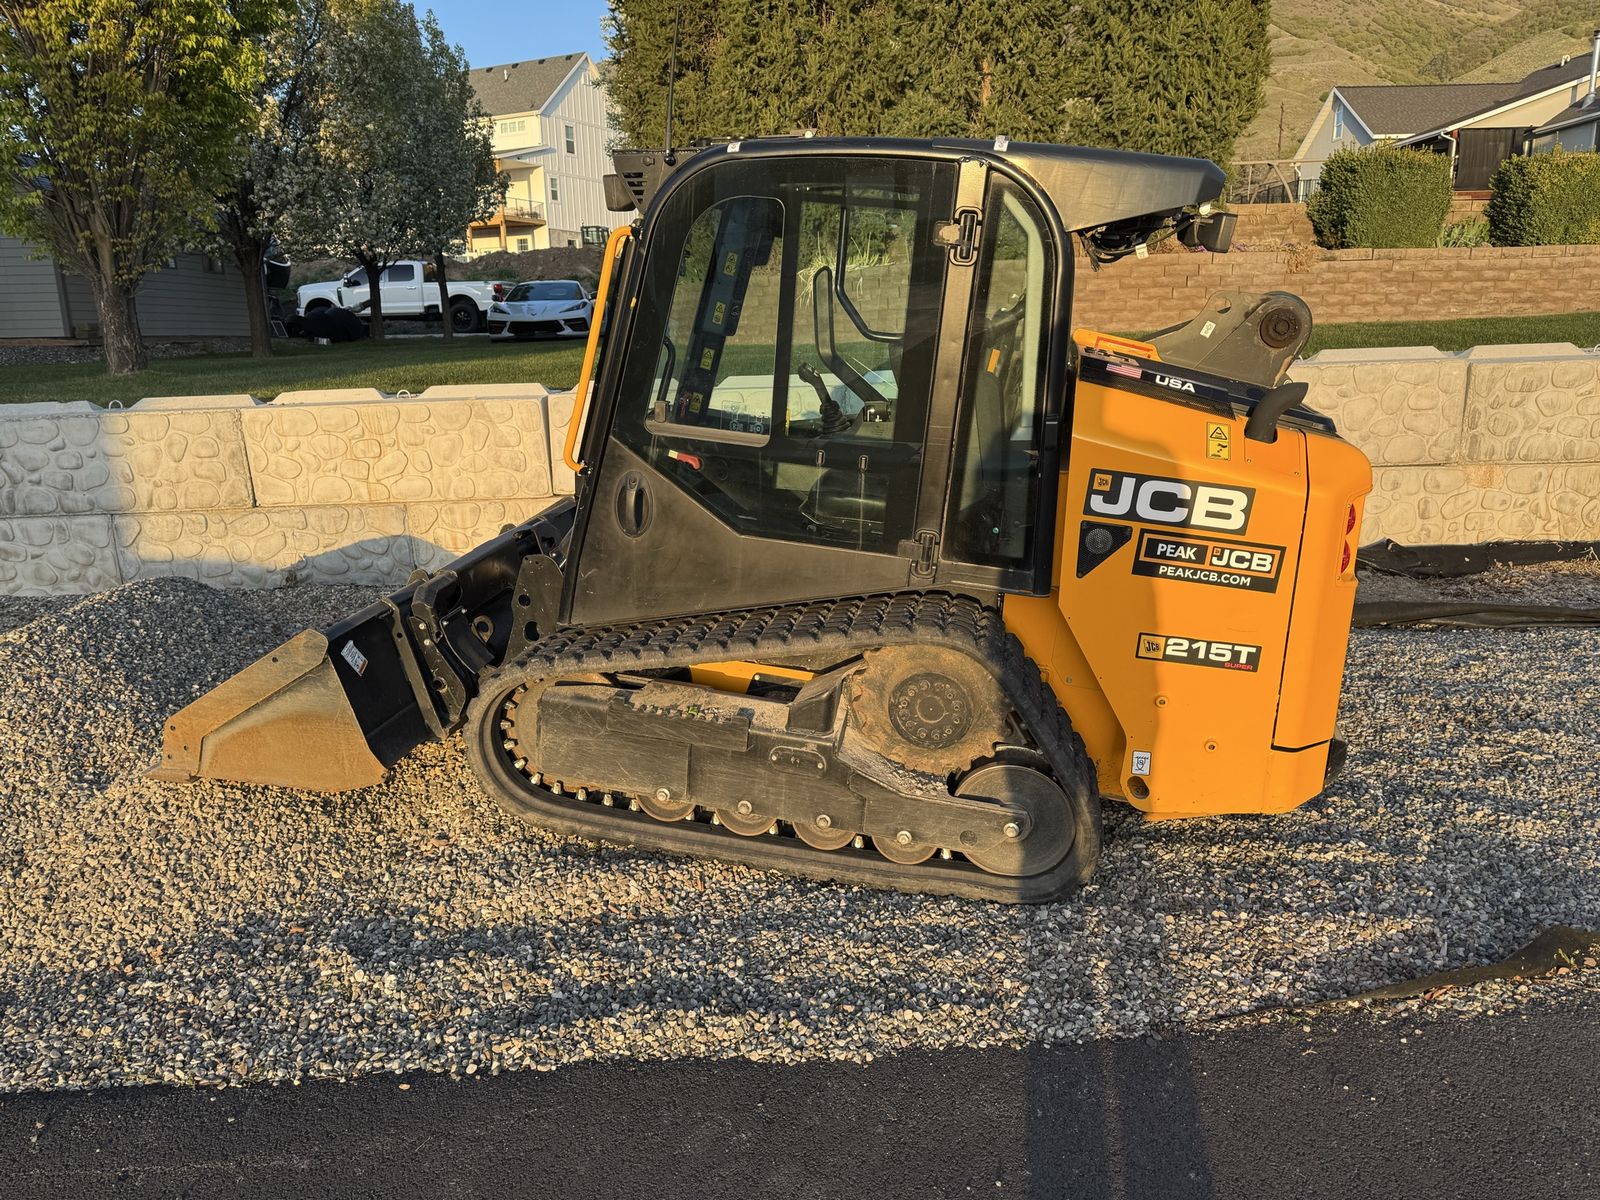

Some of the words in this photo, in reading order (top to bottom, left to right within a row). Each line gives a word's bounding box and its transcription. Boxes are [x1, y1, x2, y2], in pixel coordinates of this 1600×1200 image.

[1155, 374, 1196, 393] USA
[1089, 476, 1248, 530] JCB
[1156, 543, 1198, 561] PEAK
[1211, 548, 1273, 572] JCB
[1158, 565, 1251, 586] PEAKJCB.COM
[1145, 640, 1160, 652] JCB
[1165, 637, 1257, 664] 215T
[1224, 662, 1253, 671] SUPER
